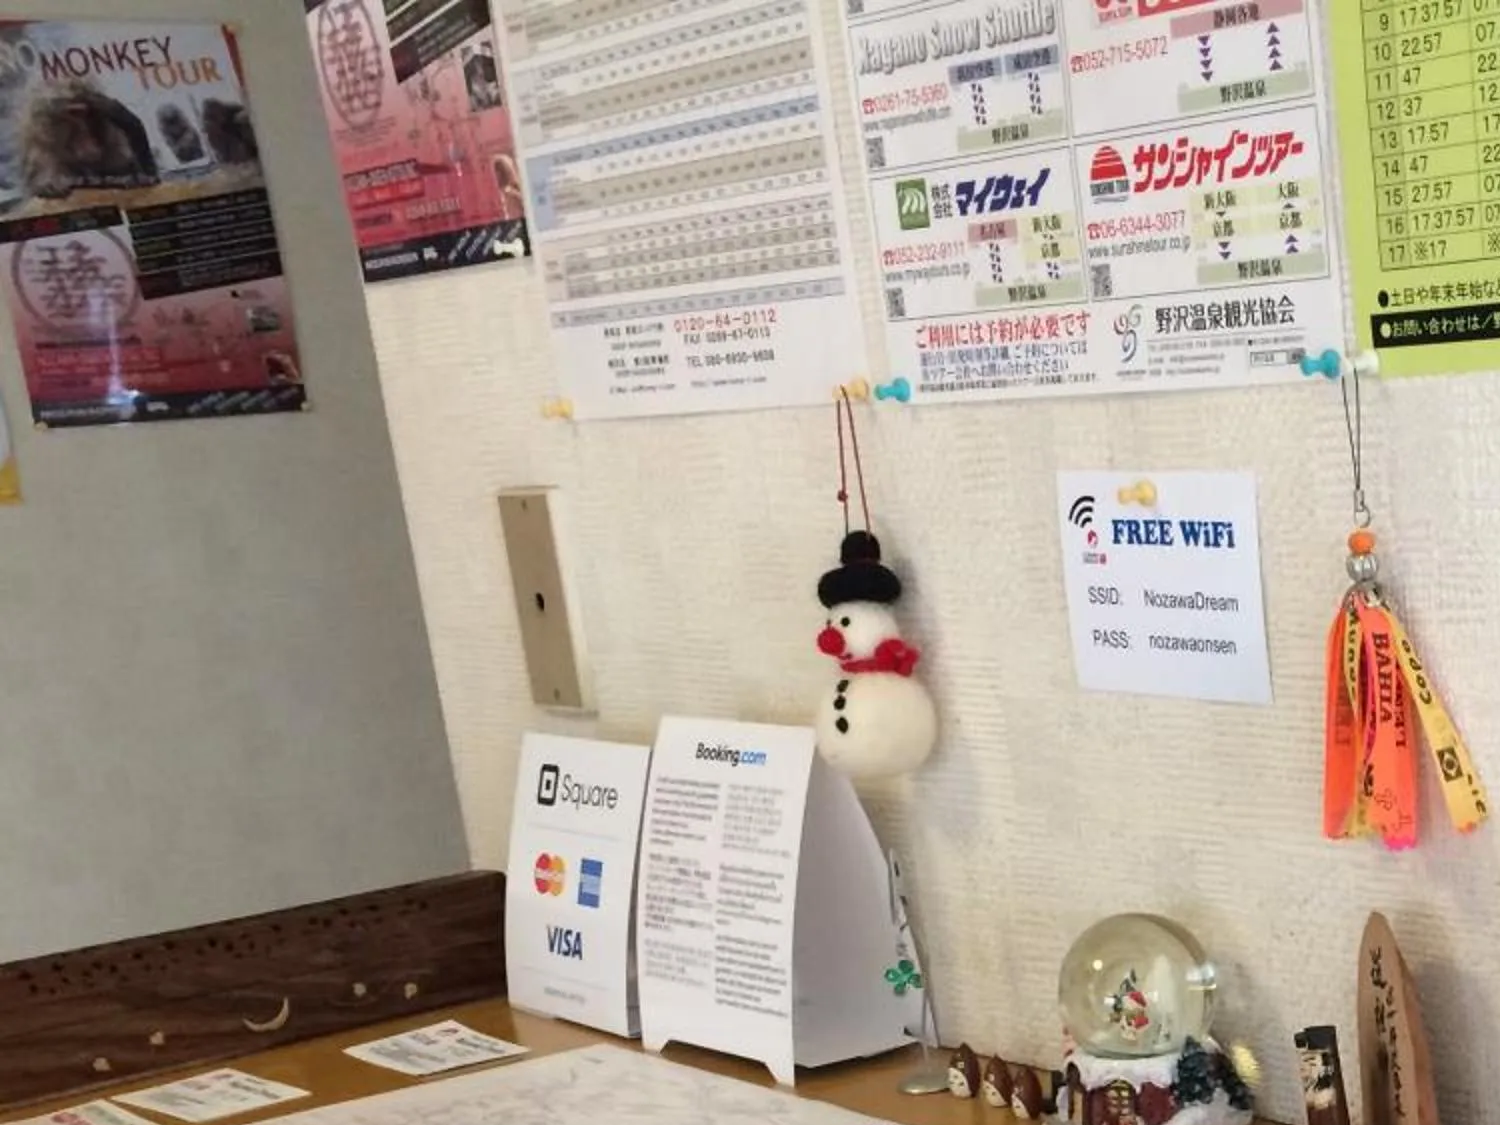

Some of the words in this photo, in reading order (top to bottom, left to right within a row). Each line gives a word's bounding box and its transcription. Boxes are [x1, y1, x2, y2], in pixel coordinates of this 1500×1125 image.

[1379, 13, 1390, 31] 9
[40, 35, 171, 80] MONKEY
[1374, 42, 1391, 61] 10
[130, 58, 223, 90] TOUR
[1375, 72, 1391, 90] 11
[1402, 67, 1421, 85] 47
[1377, 101, 1395, 120] 12
[1403, 96, 1422, 116] 37
[1380, 131, 1398, 149] 13
[1133, 130, 1304, 193] サンシャインツアー
[1382, 159, 1400, 177] 14
[1409, 155, 1428, 171] 47
[1385, 188, 1403, 206] 15
[1387, 216, 1404, 234] 16
[1388, 244, 1405, 262] 17
[1155, 294, 1295, 334] 野沢温泉観光協会
[1112, 519, 1174, 546] FREE
[1179, 520, 1235, 548] WiFi
[1143, 589, 1239, 612] NozawaDream
[1149, 633, 1237, 655] nozawaonsen
[1372, 632, 1394, 724] BAHIA
[695, 742, 767, 767] Booking.com
[560, 772, 618, 811] Square
[546, 924, 582, 960] VISA
